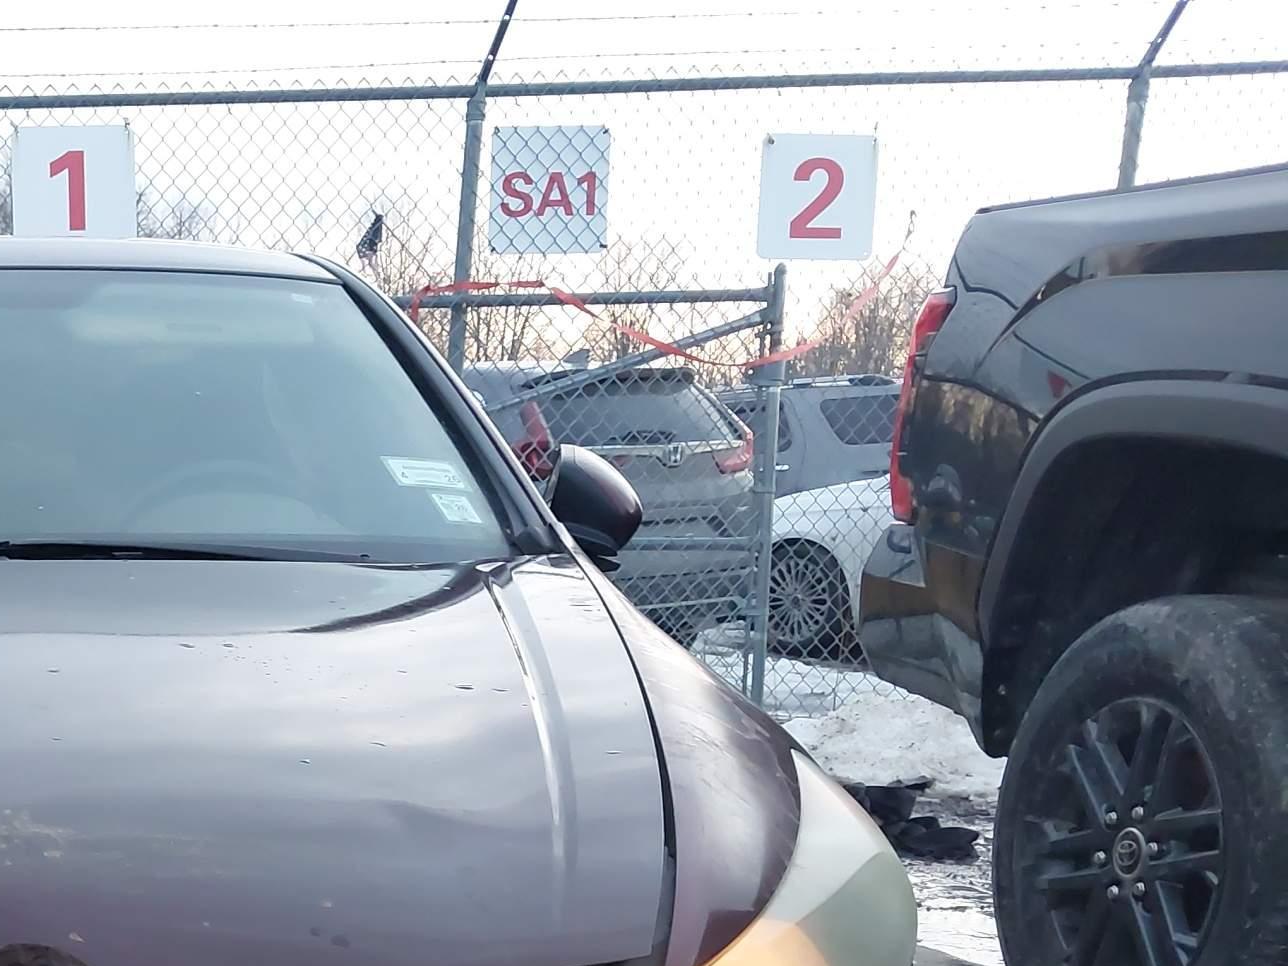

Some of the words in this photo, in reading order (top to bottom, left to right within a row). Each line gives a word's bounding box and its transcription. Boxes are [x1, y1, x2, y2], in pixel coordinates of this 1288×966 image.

[49, 150, 86, 231] 1
[500, 171, 598, 218] SA1
[791, 158, 843, 239] 2
